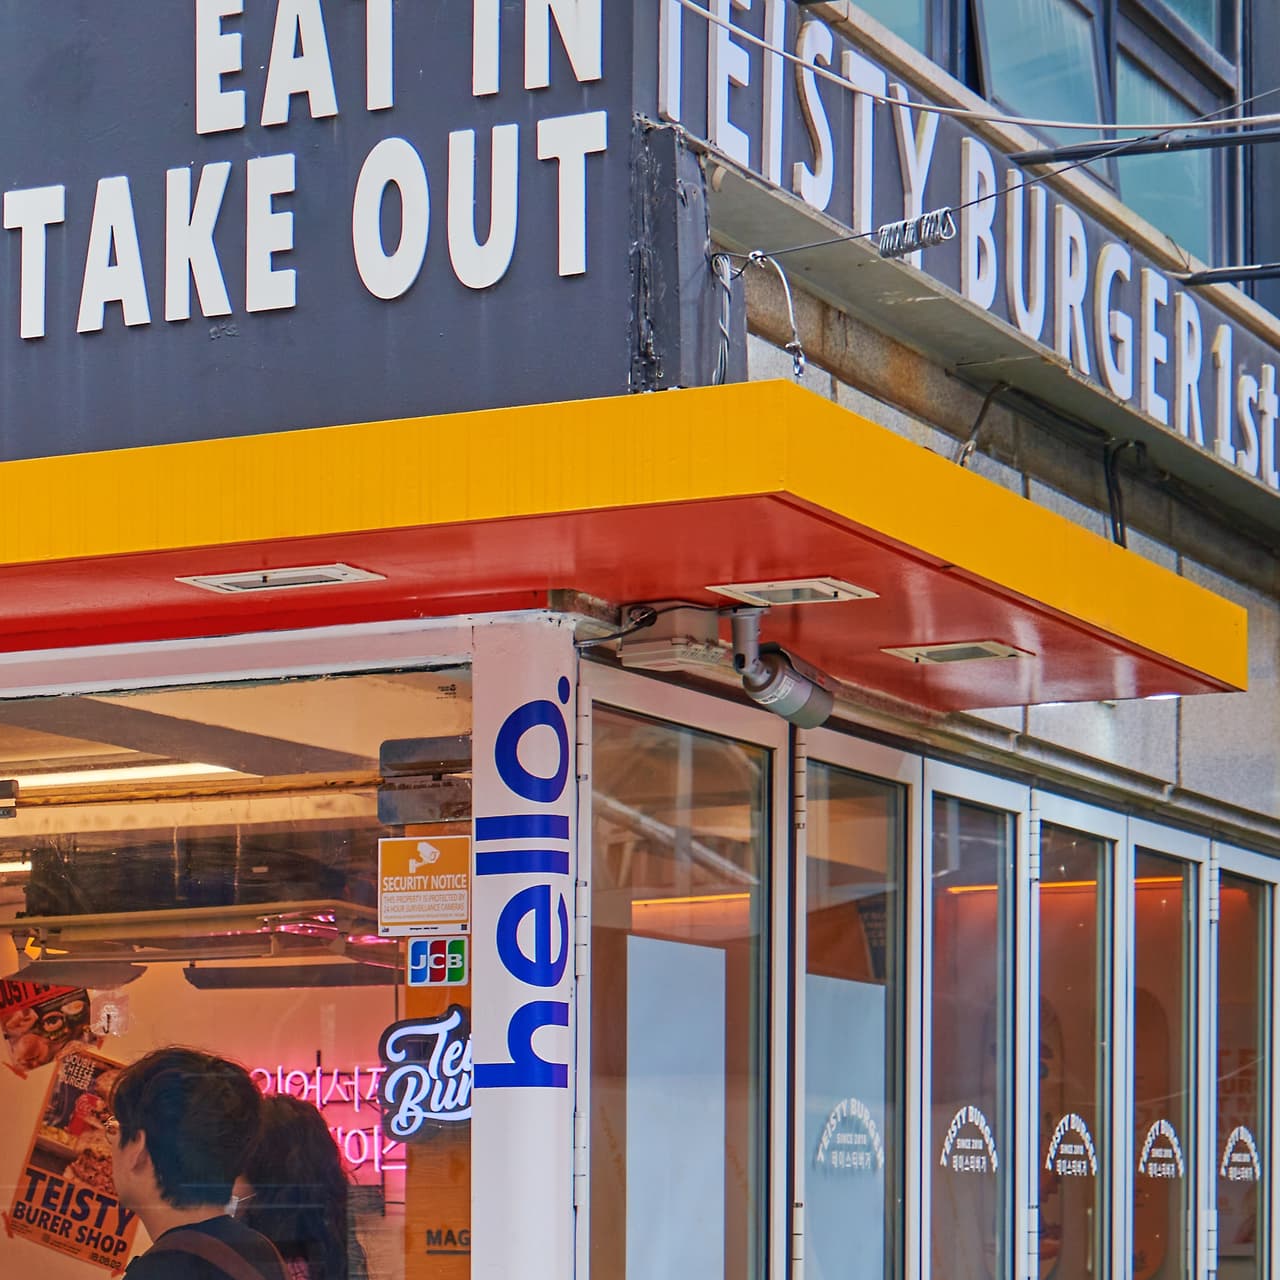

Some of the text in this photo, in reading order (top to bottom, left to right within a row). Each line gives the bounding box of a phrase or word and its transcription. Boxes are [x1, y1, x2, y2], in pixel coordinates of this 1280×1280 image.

[196, 0, 602, 134] EAT IN
[4, 110, 607, 339] TAKE OUT
[961, 137, 1204, 447] BURGER
[1212, 325, 1279, 489] 1st
[383, 873, 467, 891] SECURITY NOTICE
[411, 953, 464, 970] JCB
[12, 1201, 72, 1239] BURER
[75, 1225, 128, 1257] SHOP
[24, 1168, 136, 1238] TEISTY
